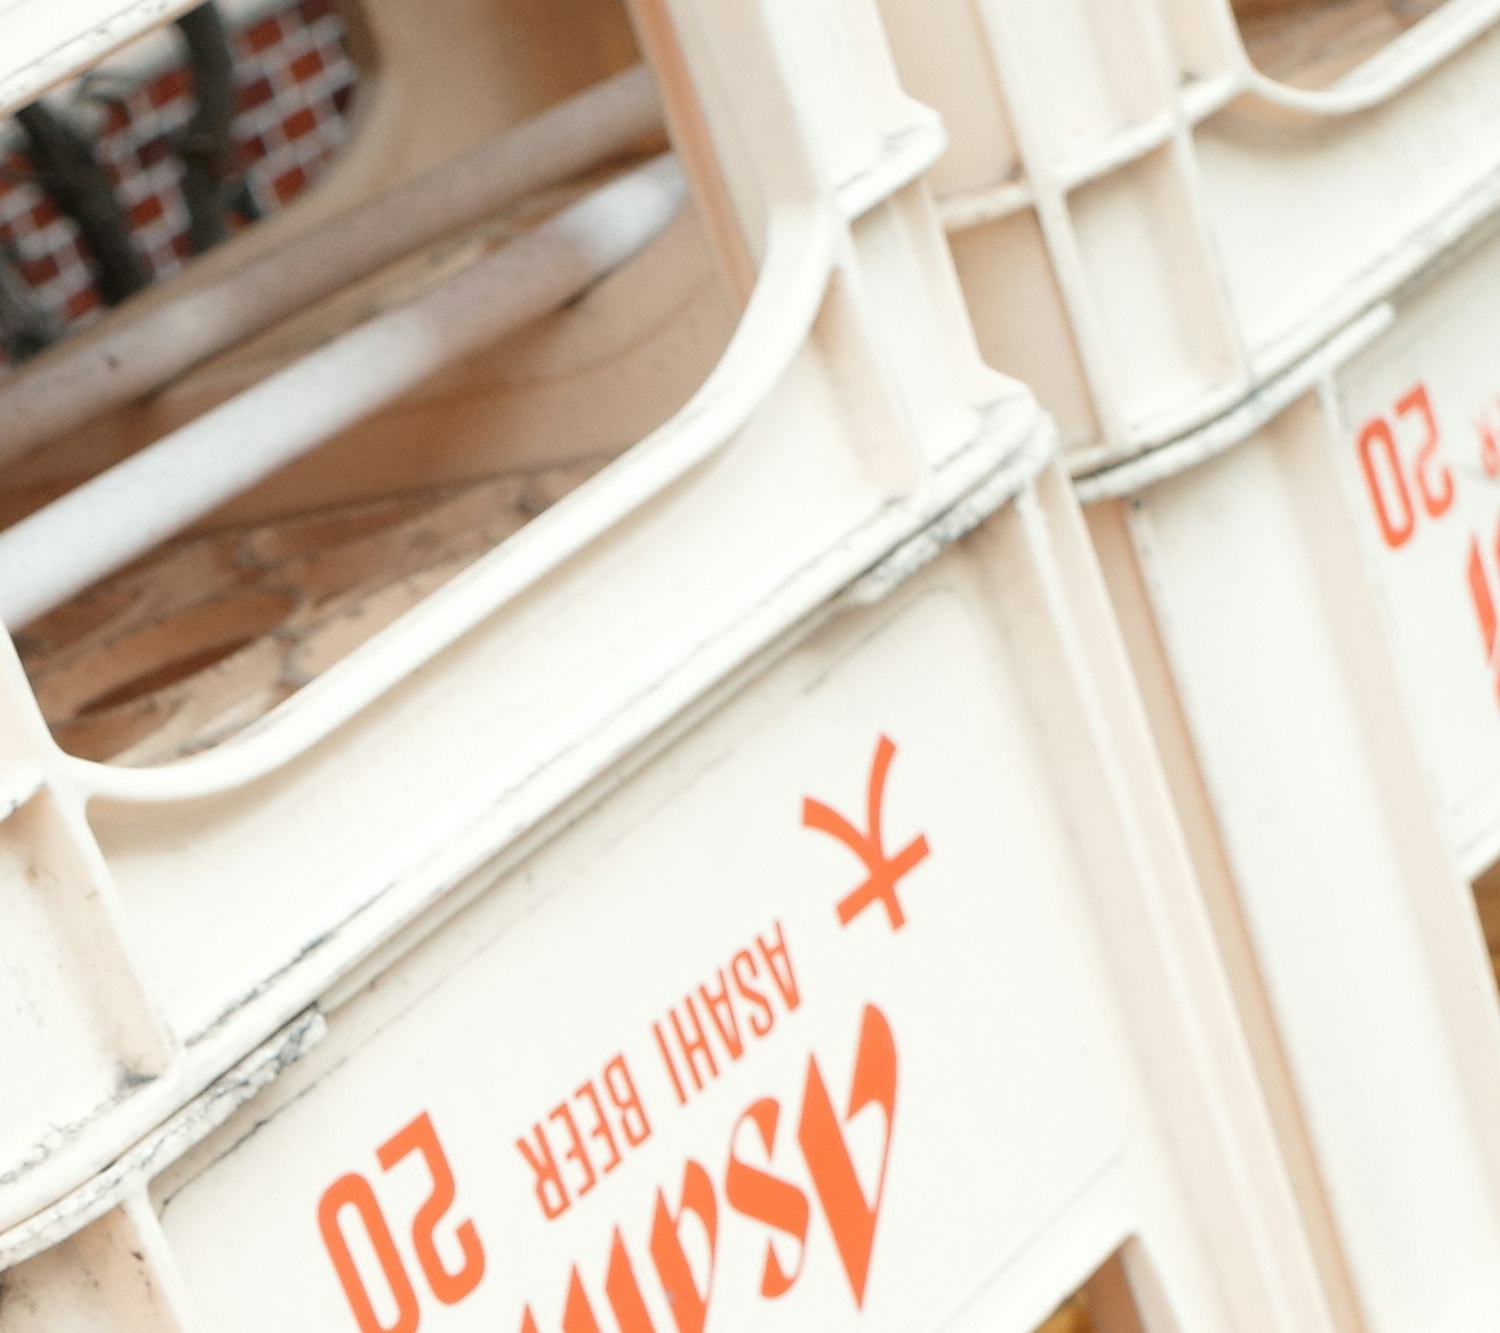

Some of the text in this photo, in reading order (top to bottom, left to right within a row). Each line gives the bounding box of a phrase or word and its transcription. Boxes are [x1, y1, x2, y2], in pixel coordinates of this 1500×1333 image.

[1355, 380, 1456, 552] 20
[800, 733, 932, 933] 大
[514, 920, 803, 1222] ASAHI BEER
